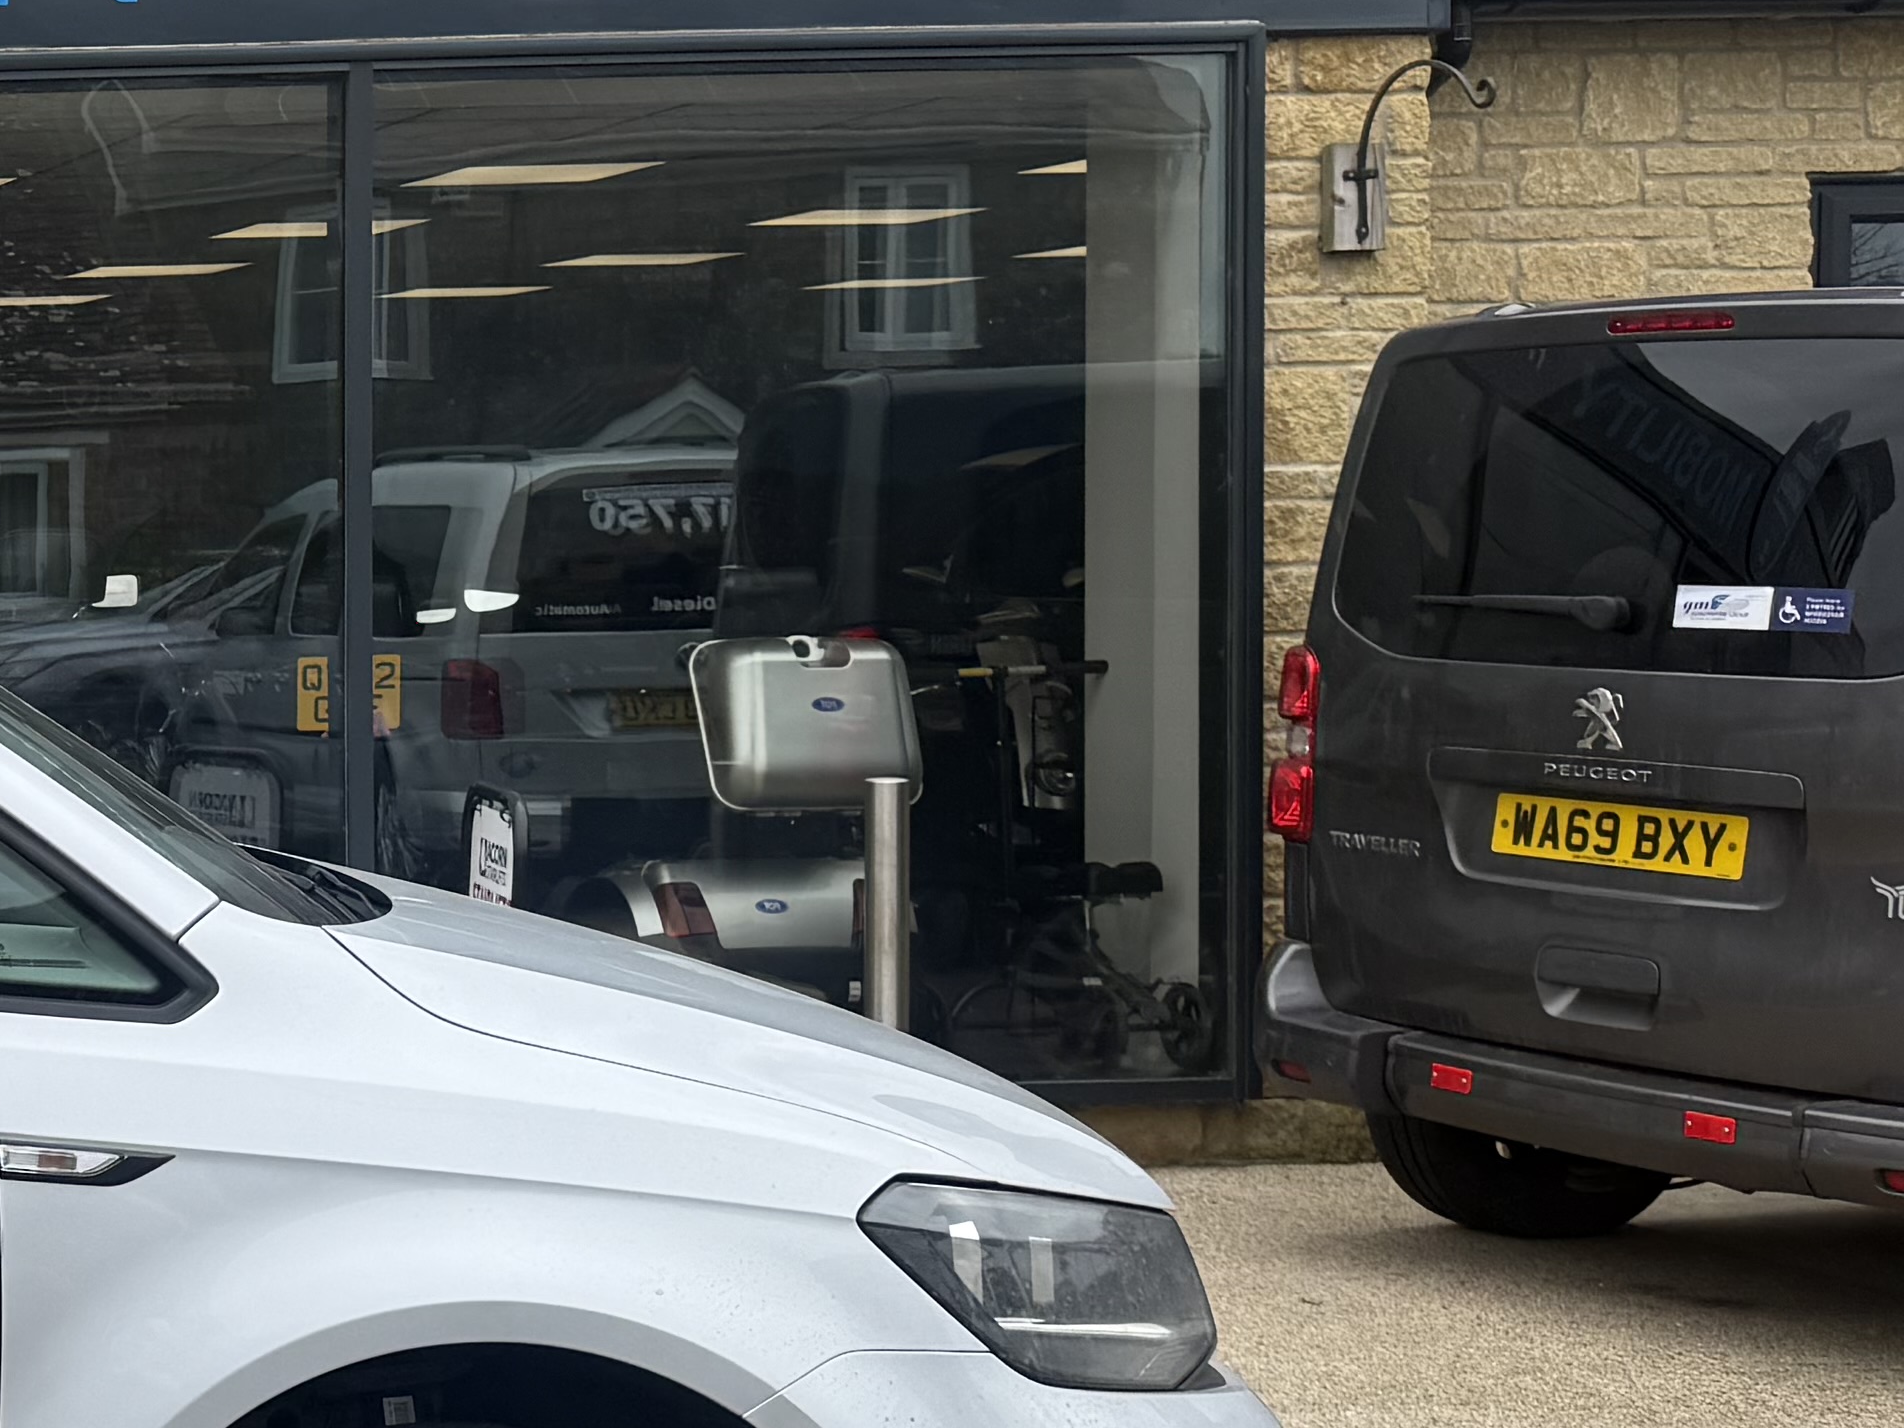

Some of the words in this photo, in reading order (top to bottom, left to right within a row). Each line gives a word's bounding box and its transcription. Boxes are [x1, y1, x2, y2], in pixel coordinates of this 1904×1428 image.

[1543, 762, 1653, 783] PEUGEOT
[1329, 830, 1421, 858] TRAVELLER
[1511, 801, 1622, 857] WA69
[1631, 813, 1729, 868] BXY
